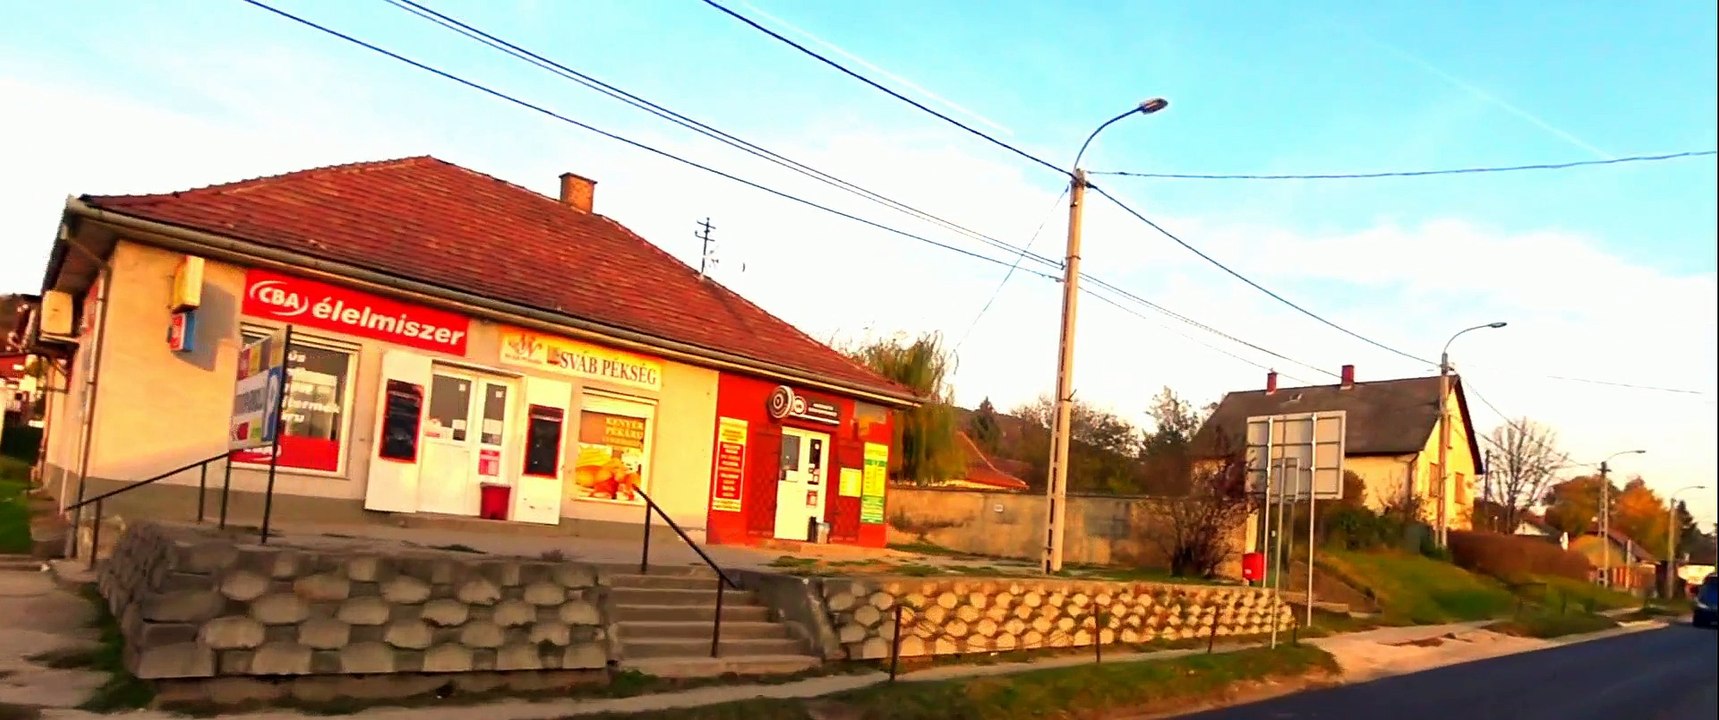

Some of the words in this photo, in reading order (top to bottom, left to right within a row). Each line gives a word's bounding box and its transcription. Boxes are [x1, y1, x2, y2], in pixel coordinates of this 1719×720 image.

[258, 286, 301, 309] CBA
[311, 296, 466, 346] élelmiszer
[559, 349, 599, 375] SVÁB
[600, 357, 657, 385] PÉKSÉG
